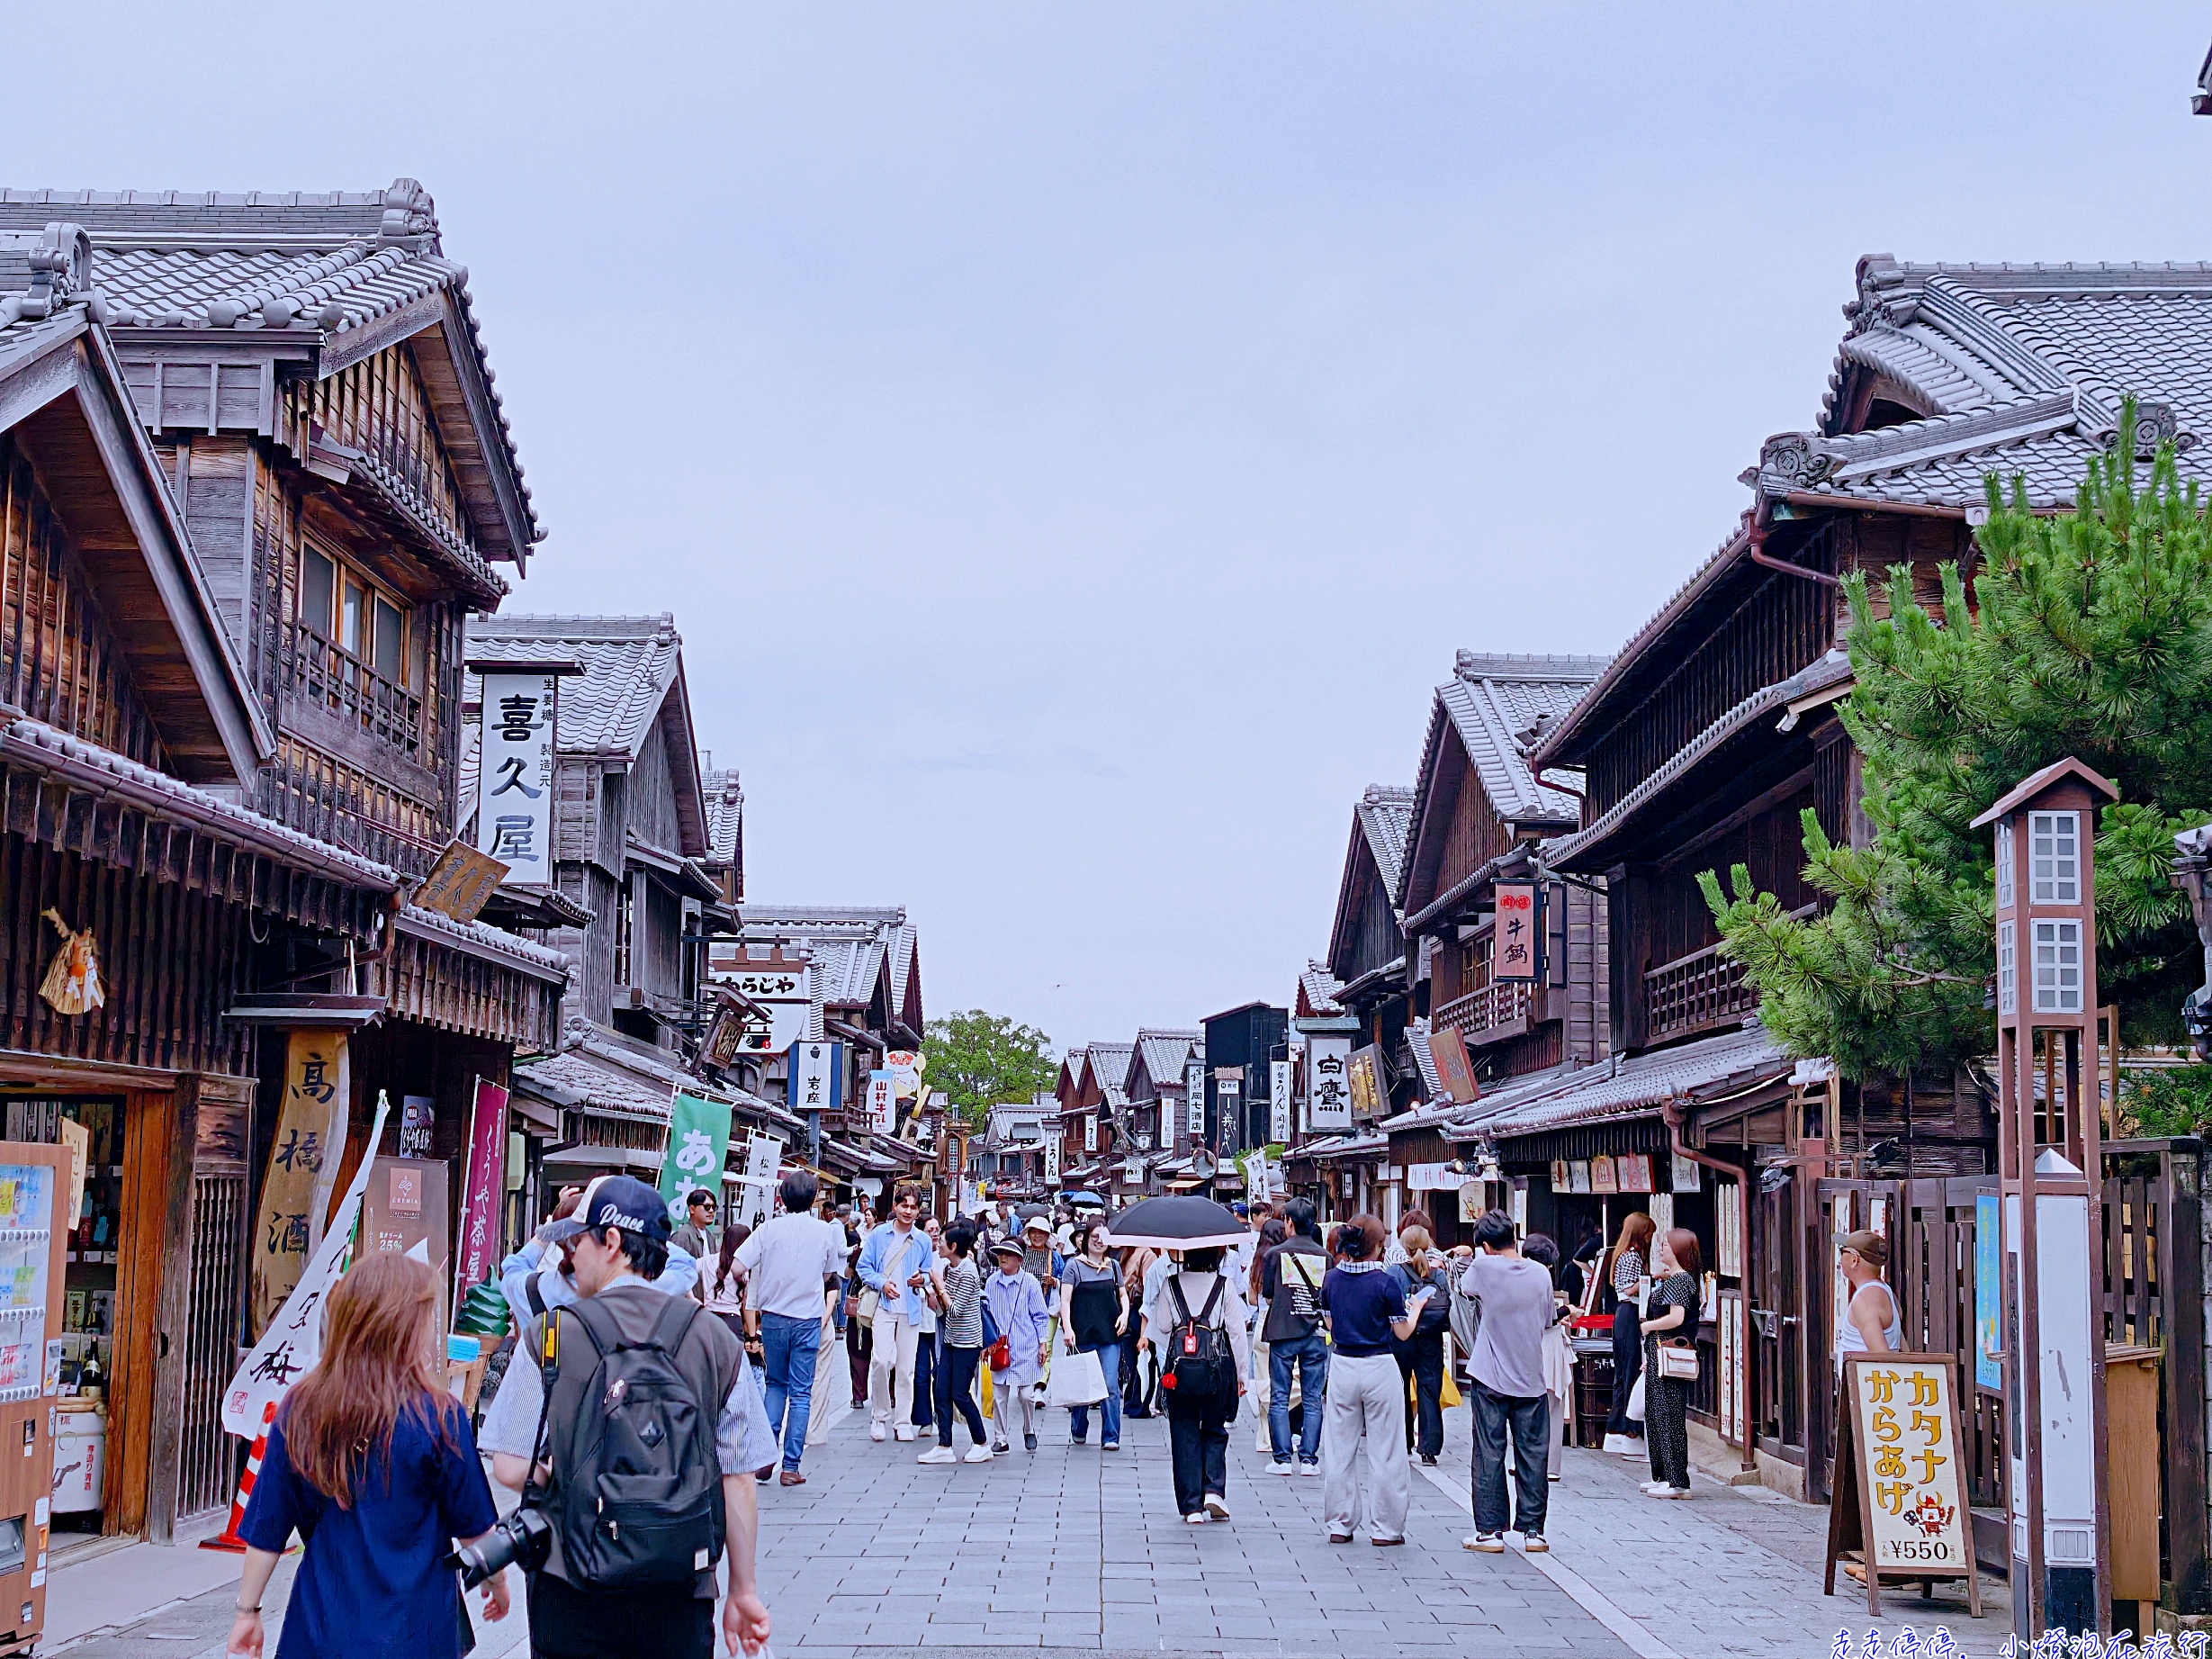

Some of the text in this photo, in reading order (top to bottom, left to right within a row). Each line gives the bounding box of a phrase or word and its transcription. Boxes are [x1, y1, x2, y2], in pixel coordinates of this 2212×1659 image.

[538, 678, 554, 788] 生姜糖 製造元
[488, 693, 544, 862] 喜久屋
[1505, 917, 1528, 964] 牛鍋
[875, 1081, 887, 1123] 山村牛乳
[1274, 1064, 1286, 1110] 伊勢うどん
[1314, 1052, 1349, 1113] 白鷹
[1191, 1092, 1203, 1131] 岡七酒店
[268, 1052, 336, 1318] 高橋酒
[668, 1129, 716, 1224] あお
[599, 1203, 644, 1232] Peace
[379, 1240, 403, 1251] 25%
[1865, 1369, 1914, 1516] からあげ
[1903, 1371, 1947, 1484] カタナ
[1890, 1539, 1948, 1560] ¥550
